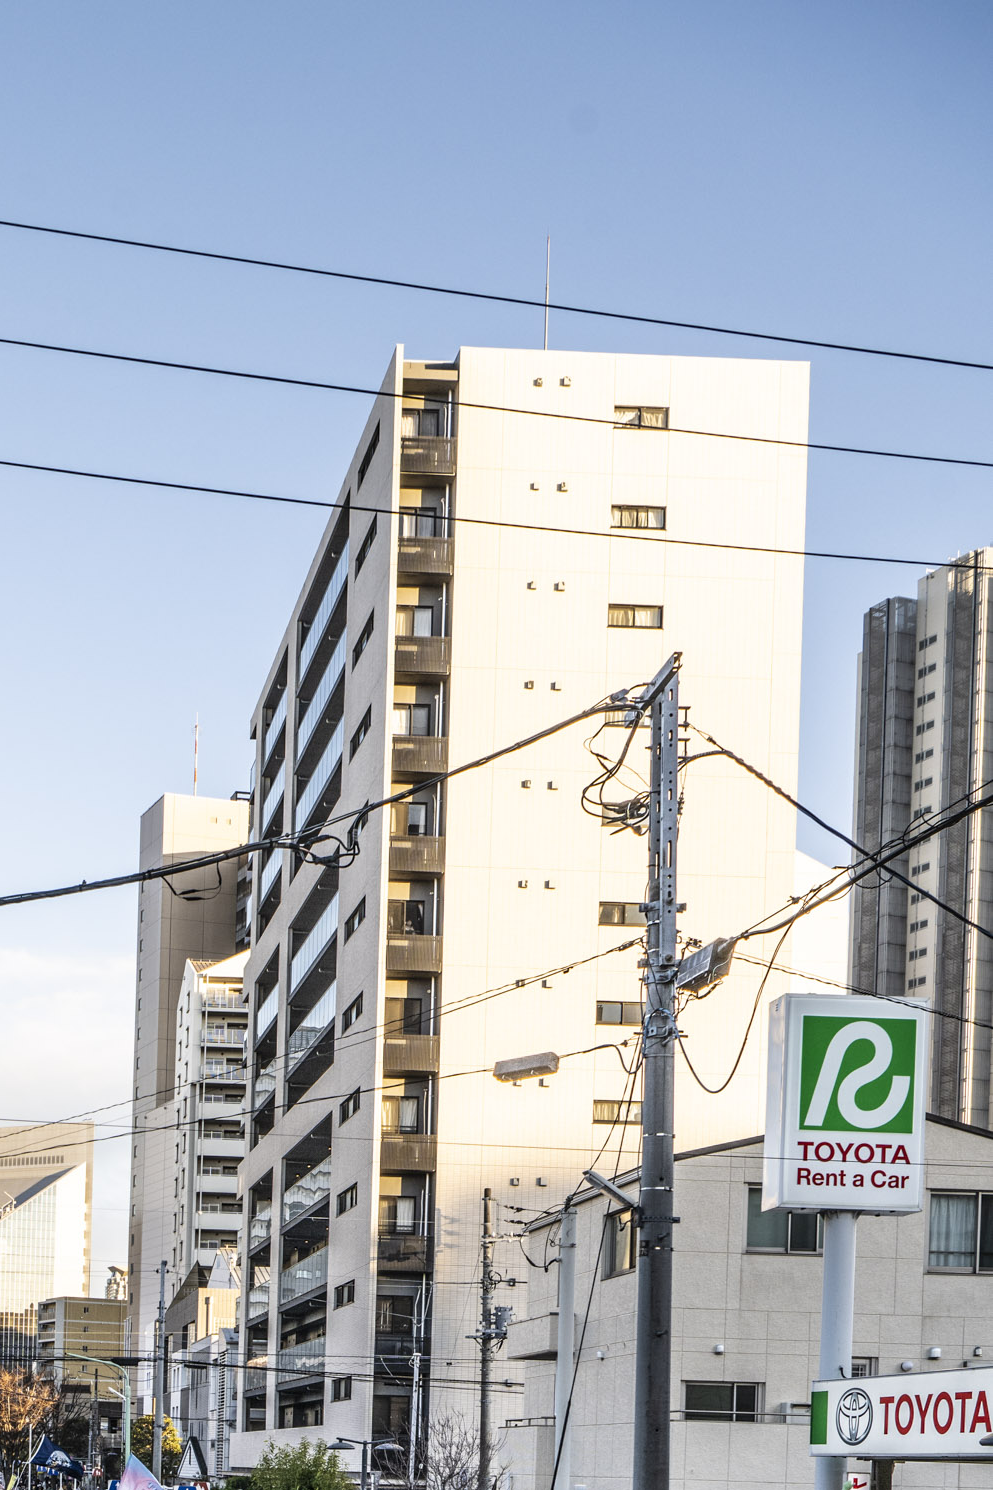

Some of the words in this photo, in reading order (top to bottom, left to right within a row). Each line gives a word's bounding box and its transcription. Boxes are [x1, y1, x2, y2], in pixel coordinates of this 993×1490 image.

[797, 1141, 911, 1164] TOYOTA
[796, 1167, 846, 1187] Rent
[852, 1174, 864, 1187] a
[870, 1170, 910, 1189] Car
[879, 1390, 992, 1435] TOYOTA
